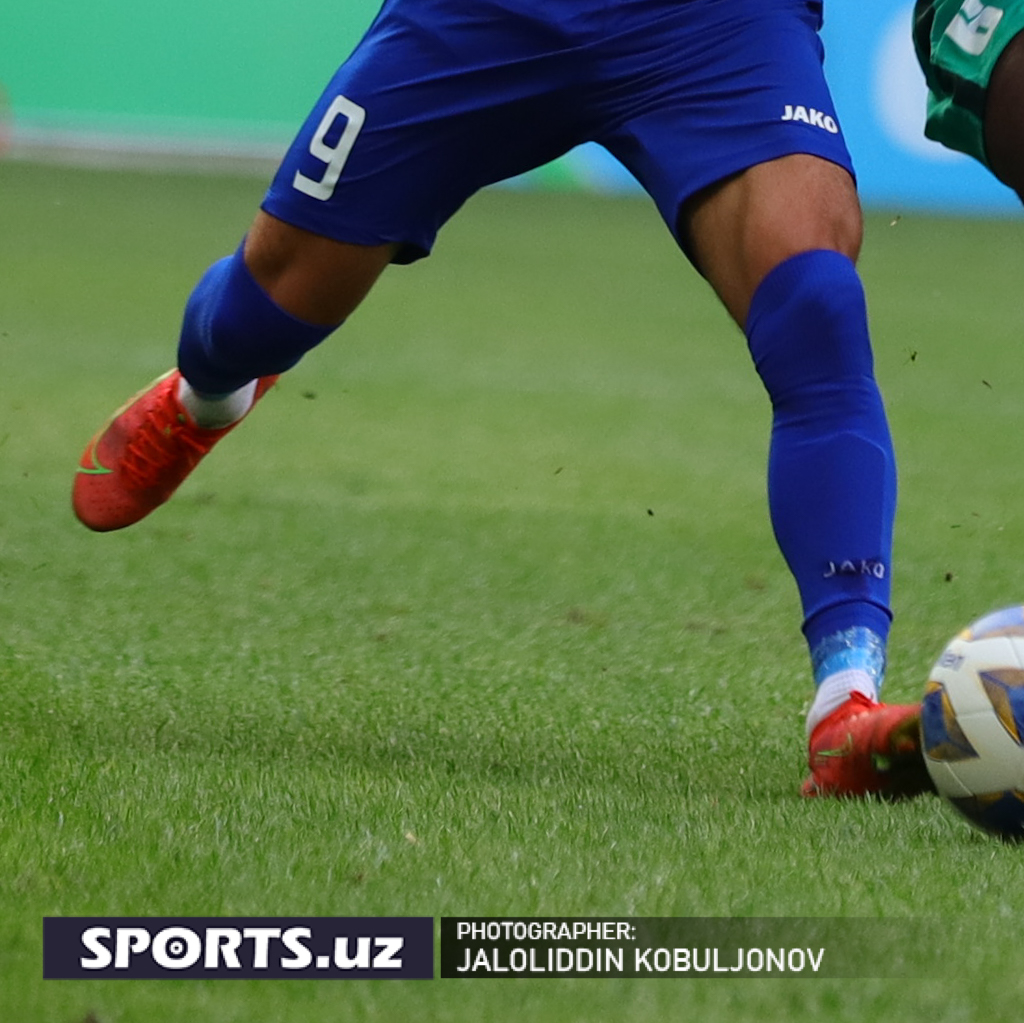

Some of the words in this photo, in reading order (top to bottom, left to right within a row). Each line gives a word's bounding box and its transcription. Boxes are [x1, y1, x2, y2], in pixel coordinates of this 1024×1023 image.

[781, 104, 839, 134] JAKO
[292, 94, 366, 202] 9
[823, 559, 885, 579] JAKO
